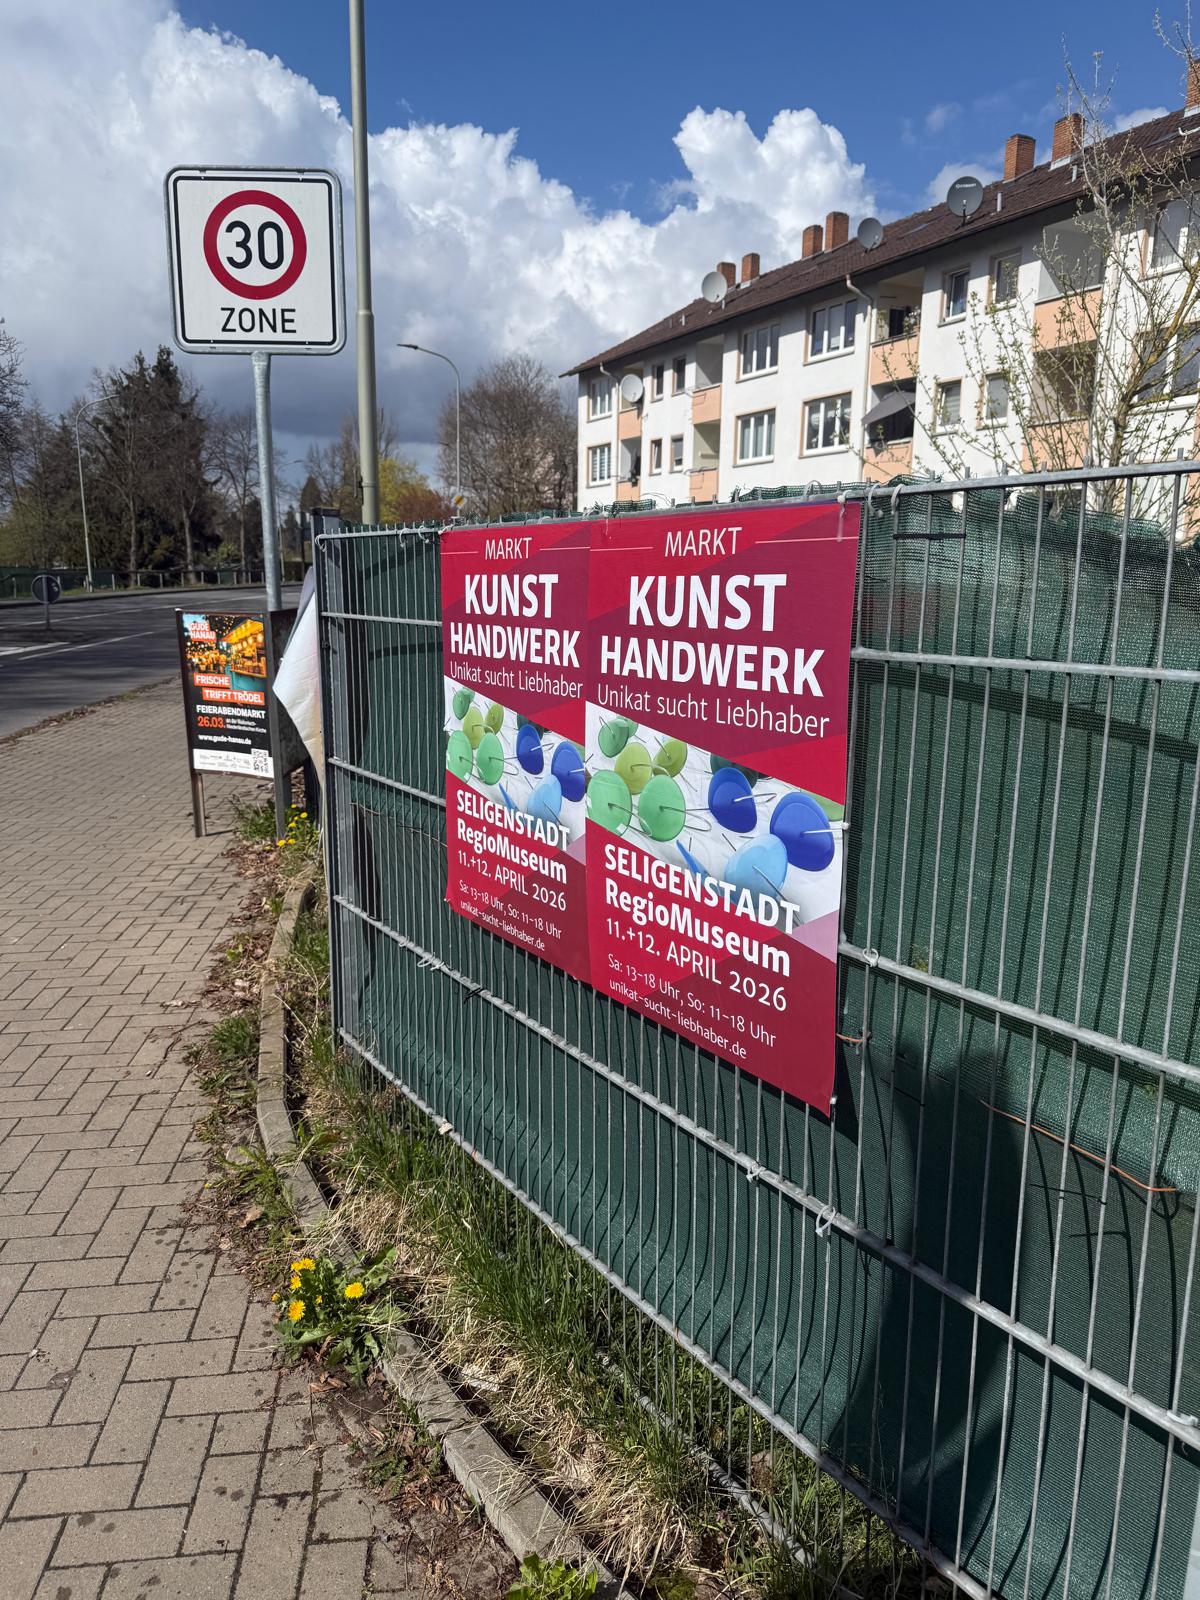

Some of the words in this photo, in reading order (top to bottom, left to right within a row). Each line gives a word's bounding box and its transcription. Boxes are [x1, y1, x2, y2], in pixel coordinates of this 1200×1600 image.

[225, 220, 284, 270] 30
[220, 307, 297, 334] ZONE
[484, 537, 533, 560] MARKT
[664, 526, 743, 558] MARKT
[464, 573, 559, 619] KUNST
[628, 573, 788, 632] KUNST
[190, 622, 210, 631] GUDE
[190, 631, 216, 640] HANAU
[450, 621, 581, 668] HANDWERK
[195, 675, 231, 686] FRISCHE
[450, 660, 482, 684] Unikat
[485, 667, 515, 689] sucht
[518, 670, 584, 699] Liebhaber
[600, 634, 825, 698] HANDWERK
[195, 704, 266, 719] FEIERABENDMARKT
[204, 689, 232, 700] TRIFFT
[233, 690, 263, 703] TRÖDEL
[597, 683, 651, 713] Unikat
[657, 692, 708, 721] sucht
[715, 698, 830, 739] Liebhaber
[197, 715, 226, 729] 26.03.
[198, 734, 252, 746] www.gude-hanau.de
[456, 789, 571, 852] SELIGENSTADT
[457, 817, 567, 885] RegioMuseum
[457, 850, 492, 878] 11.+12.
[494, 863, 529, 896] APRIL
[532, 883, 567, 912] 2026
[604, 843, 800, 936] SELIGENSTADT
[459, 879, 469, 894] Sa:
[490, 895, 507, 916] Uhr,
[508, 903, 520, 920] So:
[545, 921, 562, 939] Uhr
[460, 900, 546, 952] unikat-sucht-liebhaber.de
[605, 877, 790, 977] RegioMuseum
[606, 917, 661, 956] 11.+12.
[666, 941, 722, 985] APRIL
[729, 970, 787, 1012] 2026
[608, 953, 623, 973] Sa:
[659, 978, 684, 1007] Uhr,
[687, 992, 706, 1014] So:
[750, 1021, 777, 1048] Uhr
[609, 978, 747, 1060] unikat-sucht-liebhaber.de
